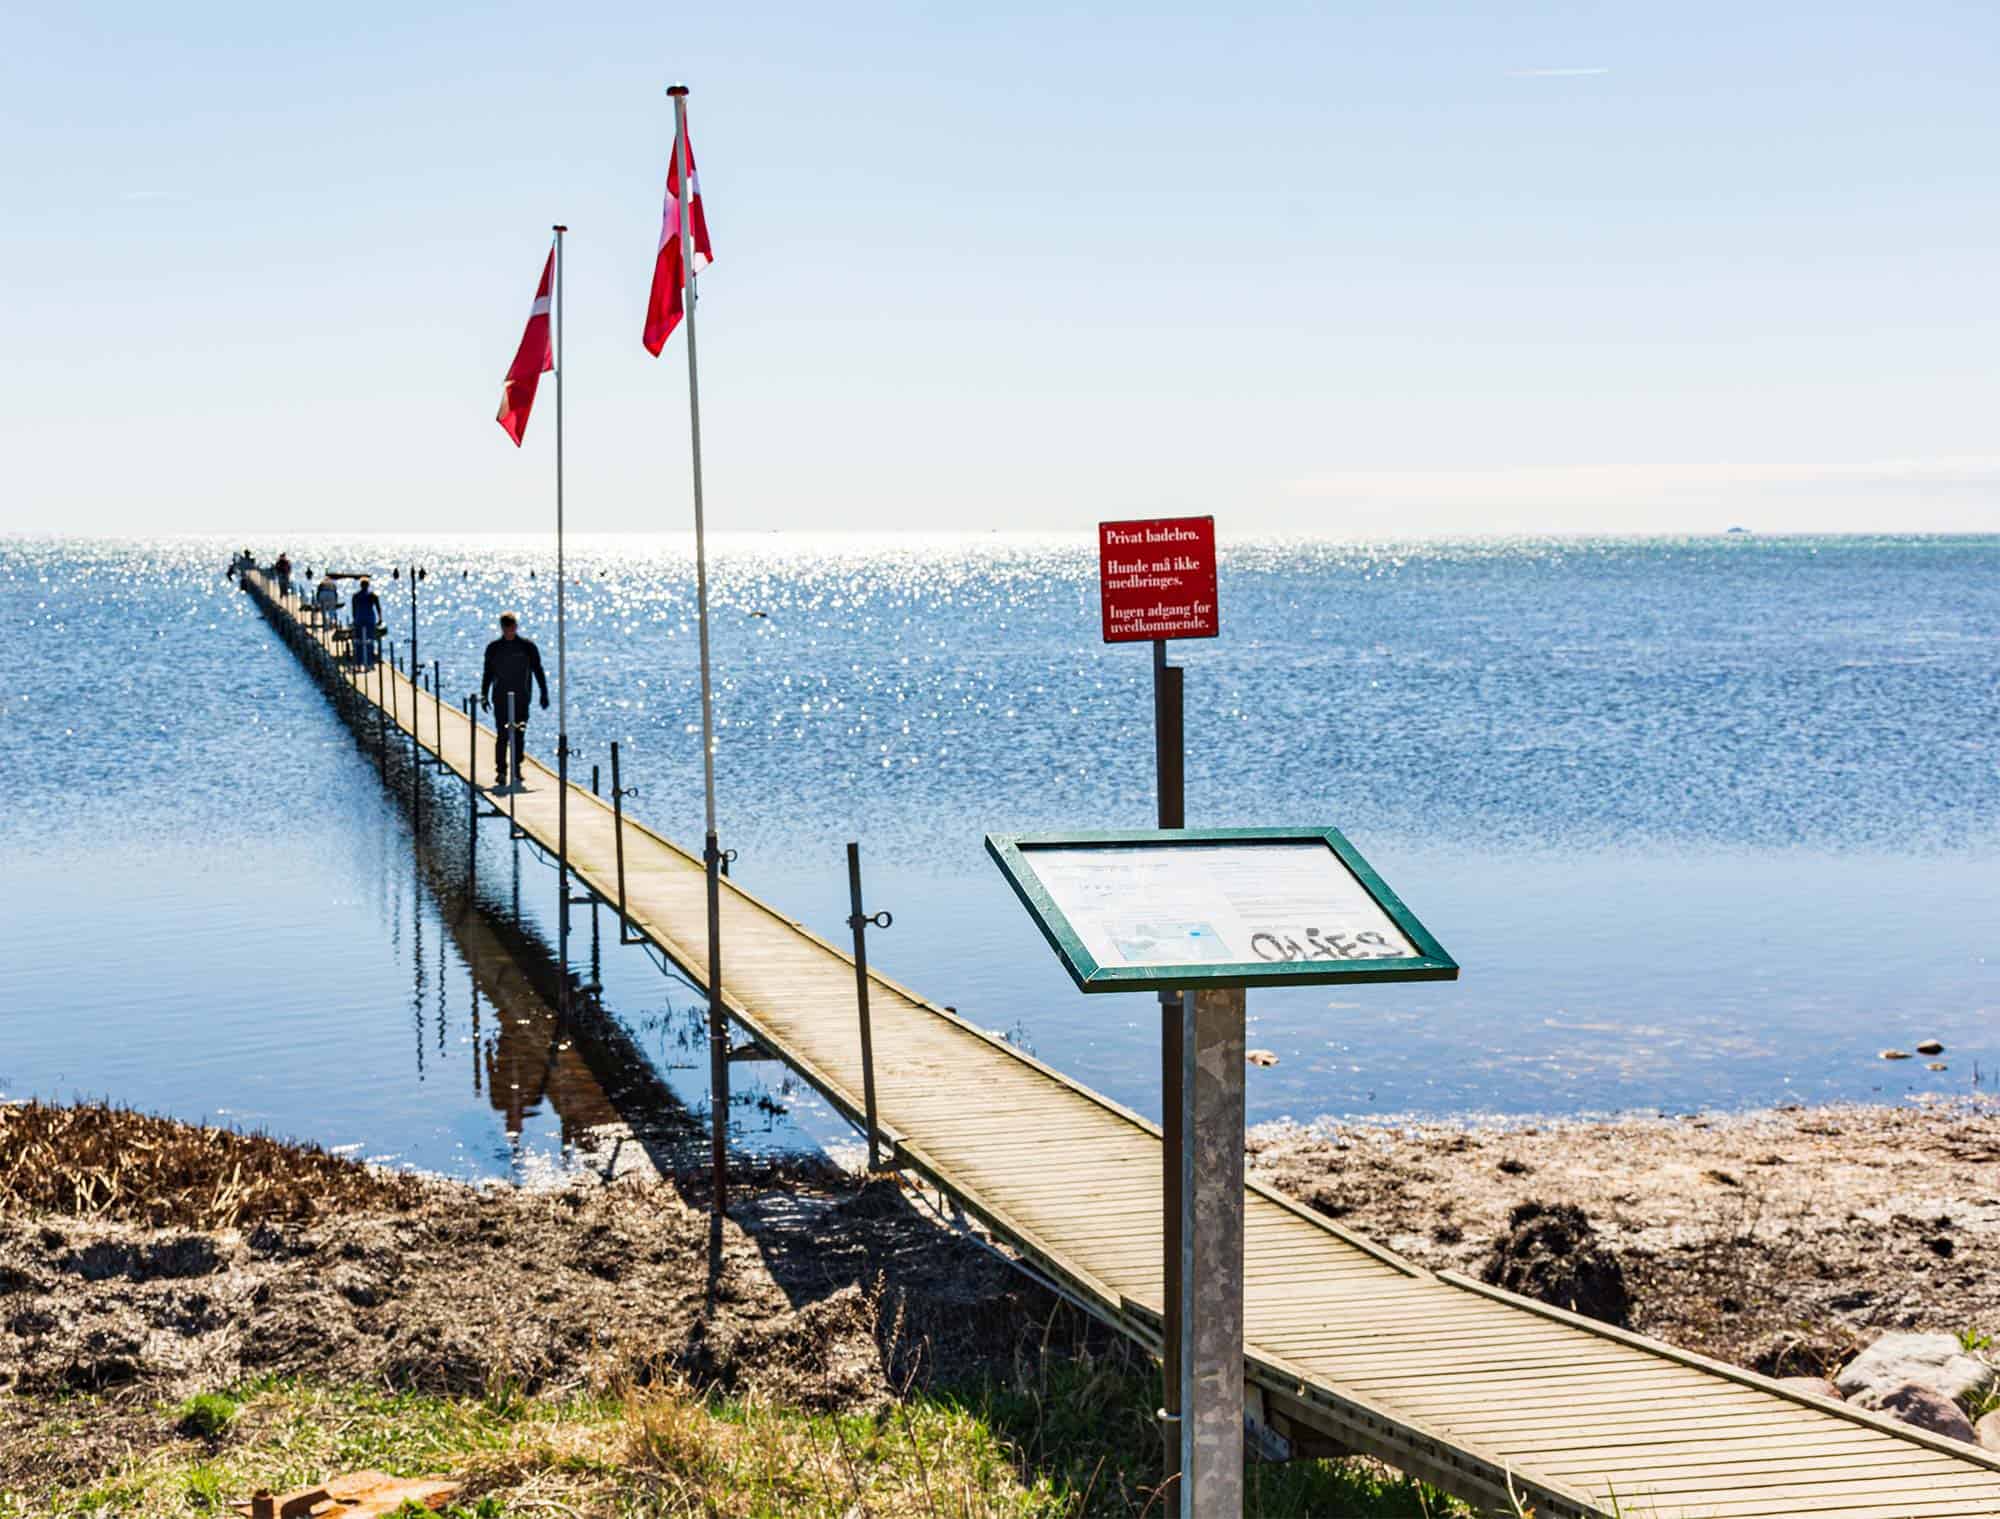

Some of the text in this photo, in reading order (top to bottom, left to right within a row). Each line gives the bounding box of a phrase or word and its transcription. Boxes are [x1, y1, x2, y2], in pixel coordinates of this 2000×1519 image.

[1106, 528, 1199, 544] Privat badebro.
[1108, 556, 1199, 574] Hunde må ikke
[1108, 574, 1183, 590] medbringes.
[1110, 600, 1211, 621] Ingen adgang for
[1111, 616, 1209, 633] uvedkommende.
